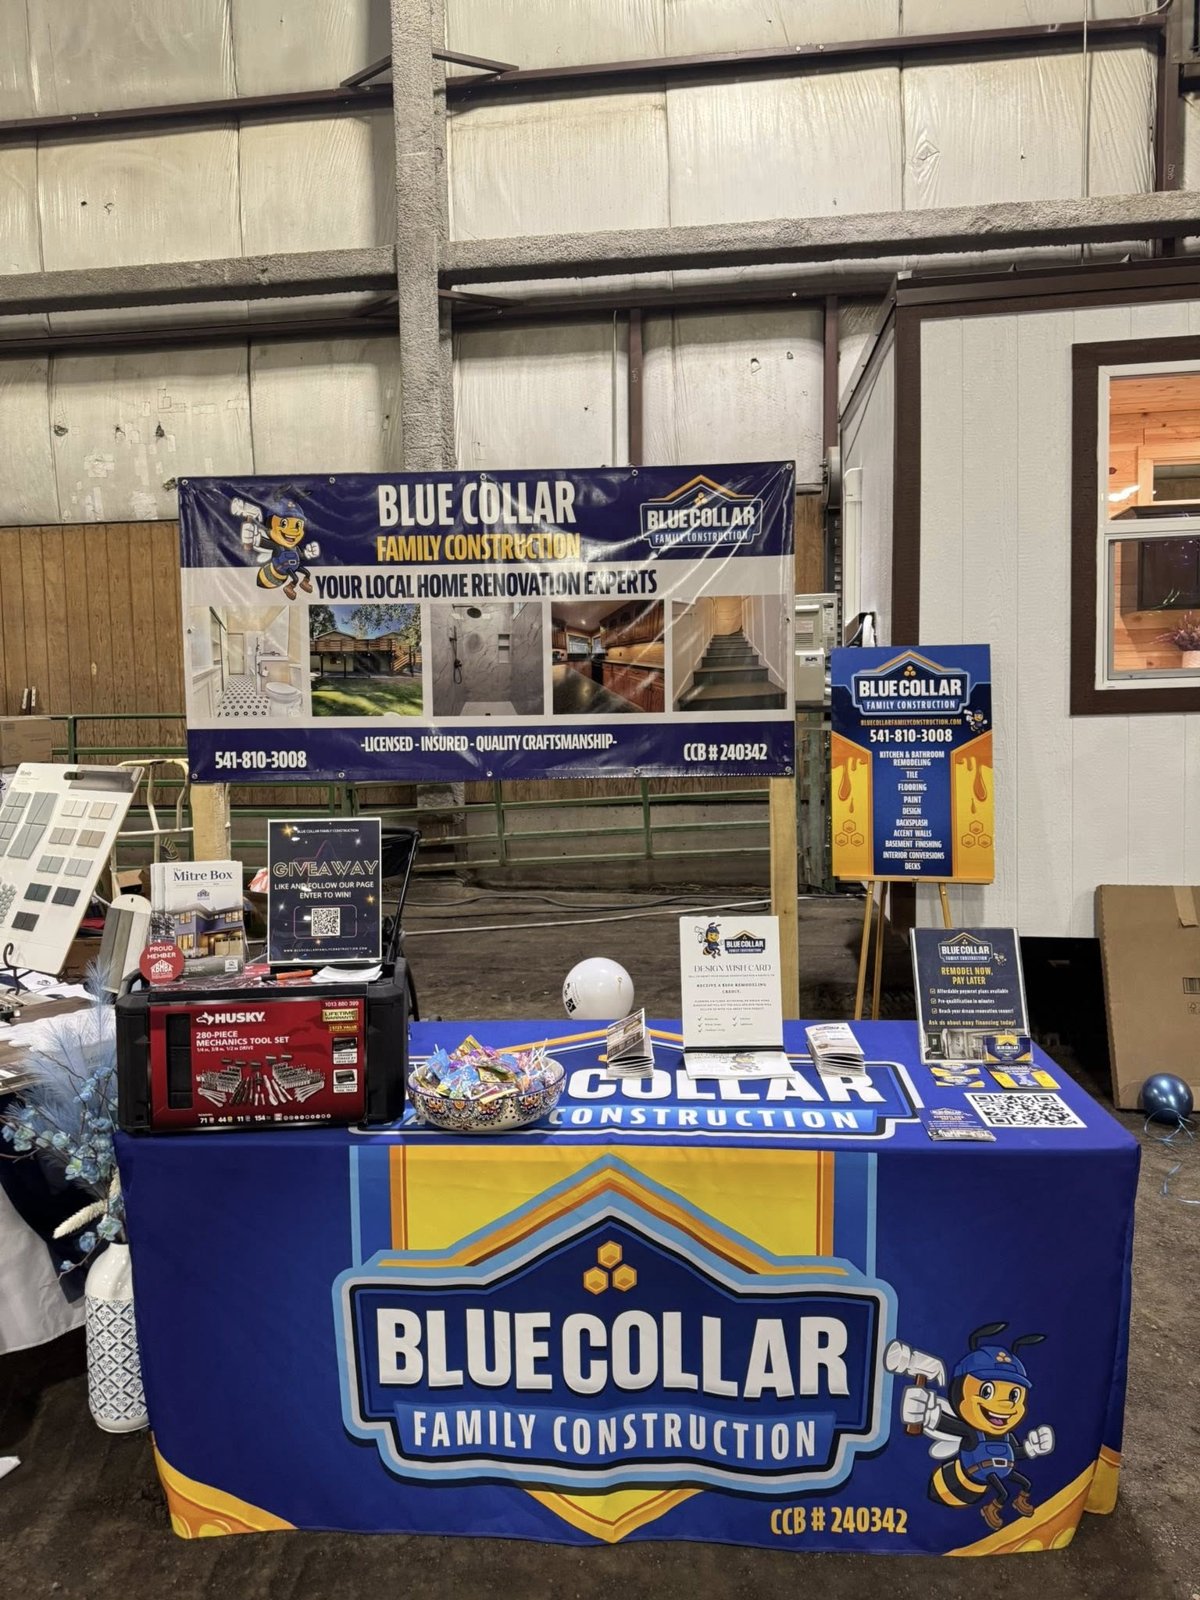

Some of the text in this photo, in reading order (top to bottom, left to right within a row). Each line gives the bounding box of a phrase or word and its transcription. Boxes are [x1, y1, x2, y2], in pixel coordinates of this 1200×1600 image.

[378, 481, 576, 526] BLUE COLLAR
[655, 530, 748, 543] FAMILY CONSTRUCTION
[376, 533, 580, 561] FAMILY CONSTRUCTION
[315, 569, 657, 600] YOUR LOCAL HOME RENOVATION EXPERTS
[866, 700, 956, 710] FAMILY CONSTRUCTION
[421, 735, 468, 751] INSURED
[476, 734, 521, 751] QUALITY
[870, 728, 952, 742] 541-810-3008
[215, 750, 306, 770] 541-810-3008
[684, 744, 768, 761] CCB # 240342
[880, 750, 904, 758] KITCHEN
[912, 750, 944, 758] BATHROOM
[174, 870, 232, 881] Mitre Box
[272, 860, 378, 877] GIVEAWAY
[941, 967, 973, 975] REMODEL
[952, 976, 986, 984] PAY LATER
[196, 1031, 238, 1039] 280-PIECE
[196, 1038, 248, 1046] MECHANICS
[568, 1068, 886, 1102] COLLAR
[549, 1107, 859, 1129] CONSTRUCTION
[414, 1410, 816, 1460] FAMILY CONSTRUCTION
[770, 1506, 908, 1535] CCB # 240342
